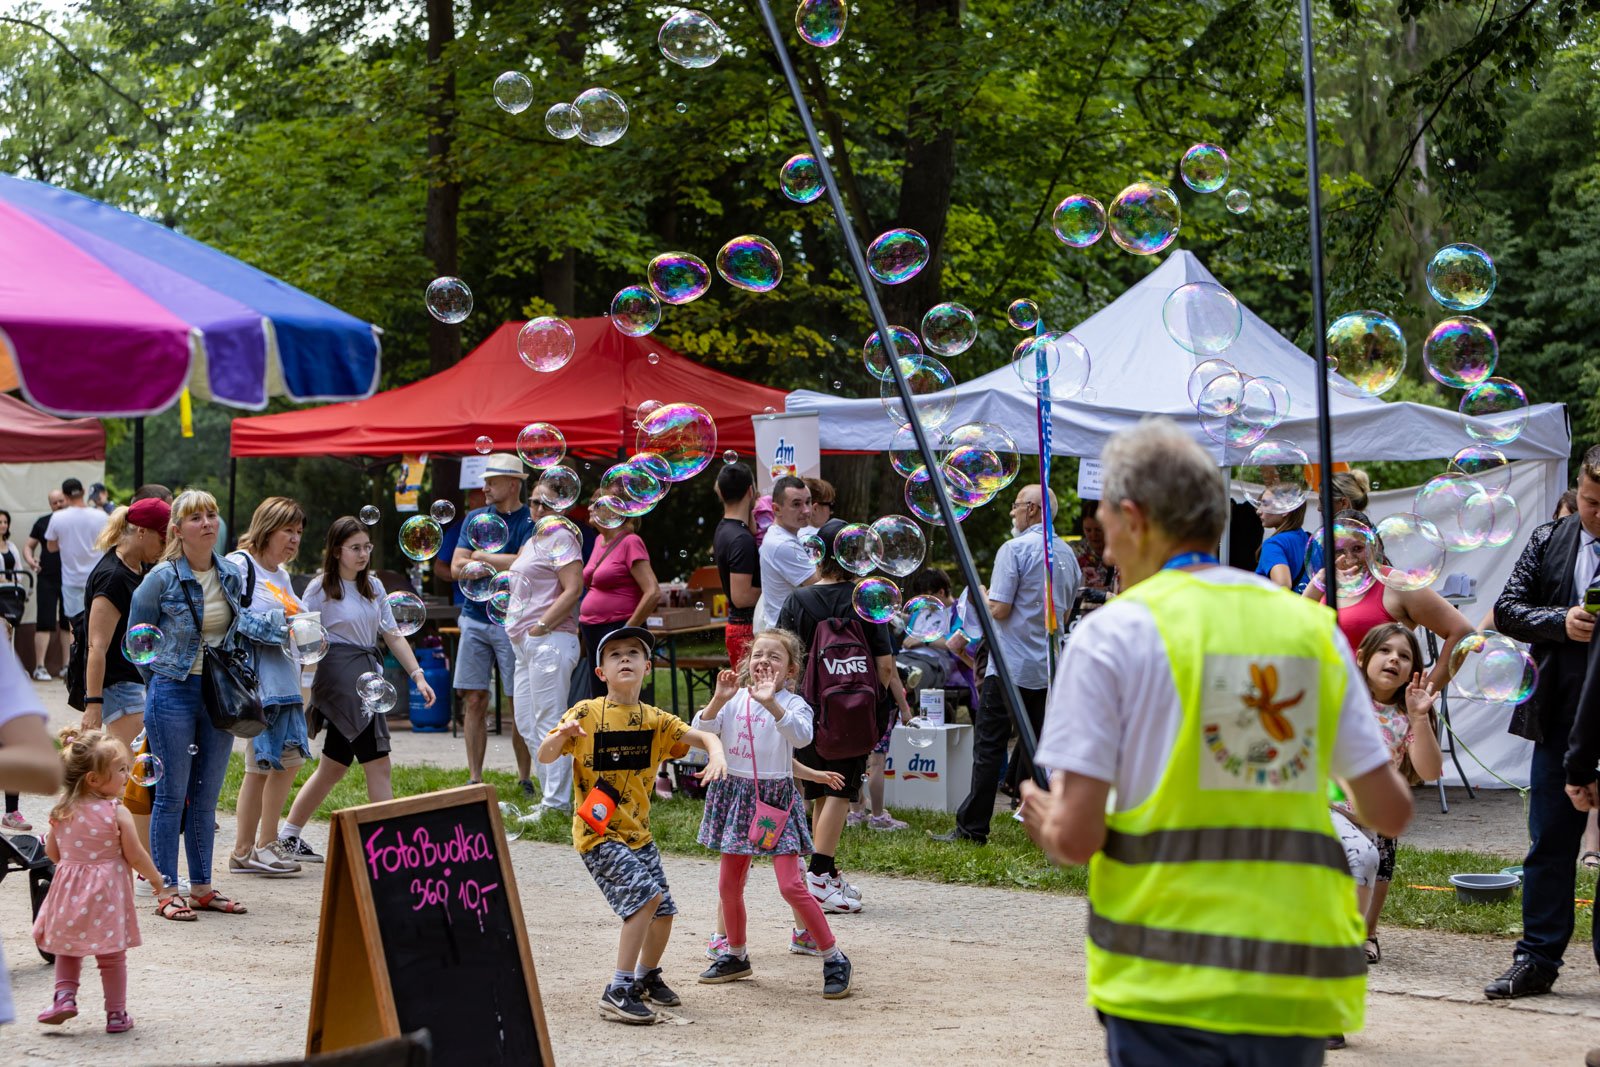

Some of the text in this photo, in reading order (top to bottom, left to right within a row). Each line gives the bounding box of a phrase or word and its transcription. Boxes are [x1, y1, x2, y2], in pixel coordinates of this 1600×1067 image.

[776, 439, 794, 464] dm
[823, 655, 869, 676] VANS
[908, 753, 936, 772] dm
